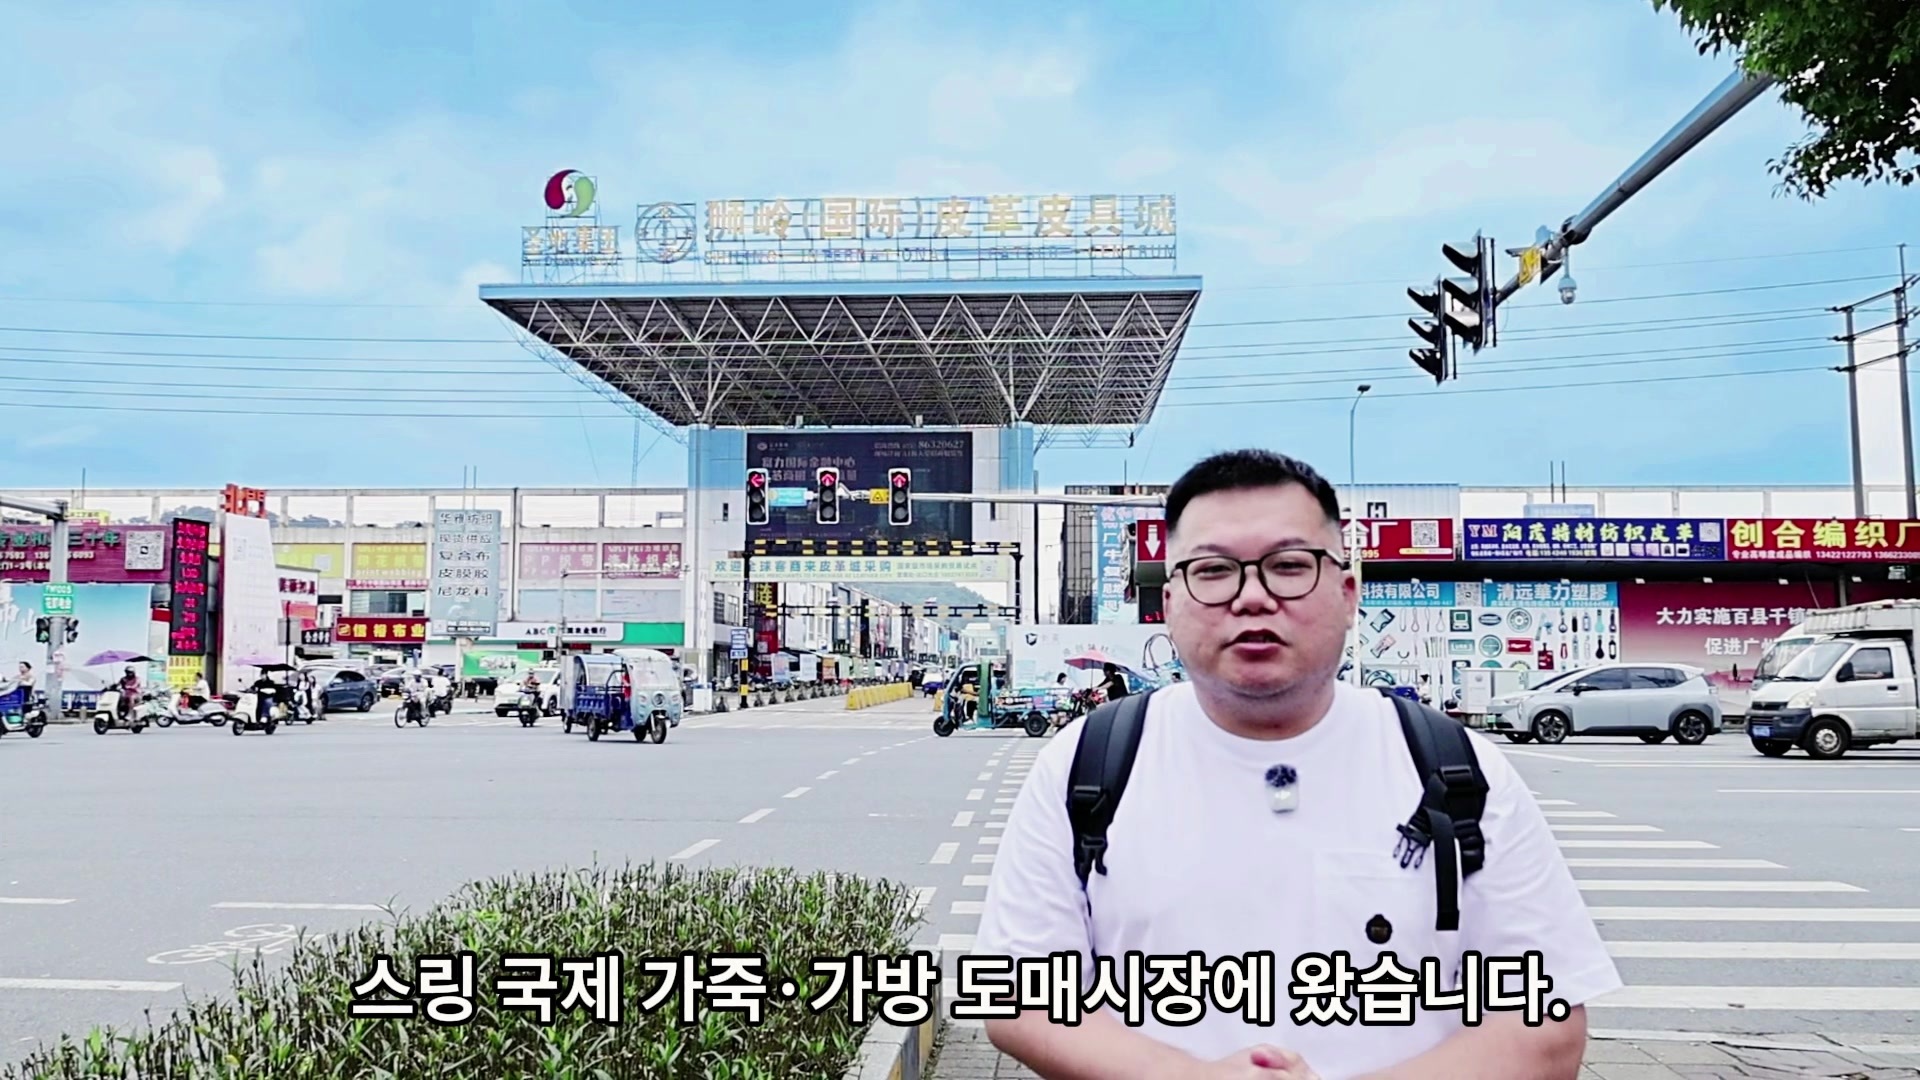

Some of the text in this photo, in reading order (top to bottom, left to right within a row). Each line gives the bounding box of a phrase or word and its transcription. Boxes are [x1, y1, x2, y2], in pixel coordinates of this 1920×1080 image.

[1468, 524, 1498, 537] YM
[1731, 520, 1920, 548] 创合编织厂
